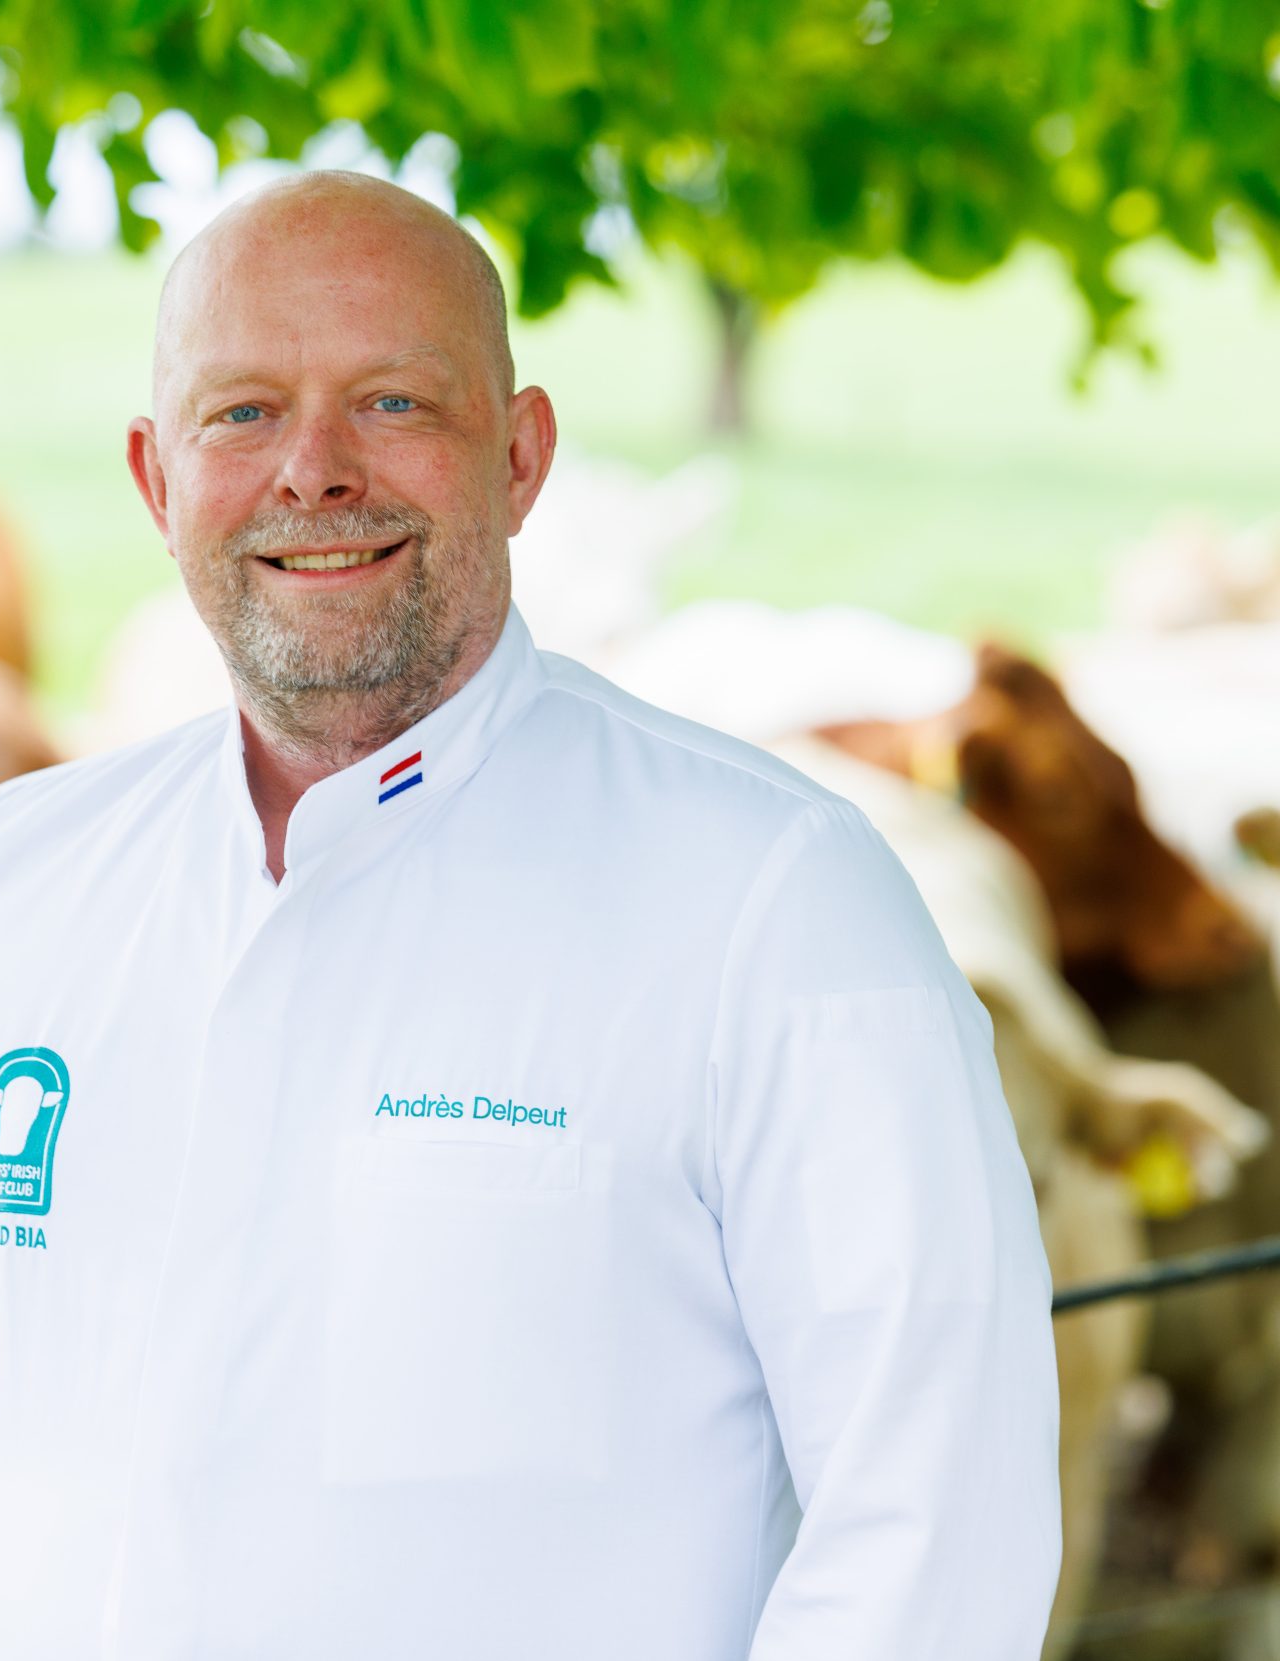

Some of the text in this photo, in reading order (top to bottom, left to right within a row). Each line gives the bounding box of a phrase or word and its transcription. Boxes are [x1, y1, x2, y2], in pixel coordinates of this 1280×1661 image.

[375, 1093, 568, 1129] Andrès Delpeut
[11, 1164, 41, 1180] IRISH
[5, 1180, 34, 1197] CLUB
[15, 1225, 47, 1250] BIA
